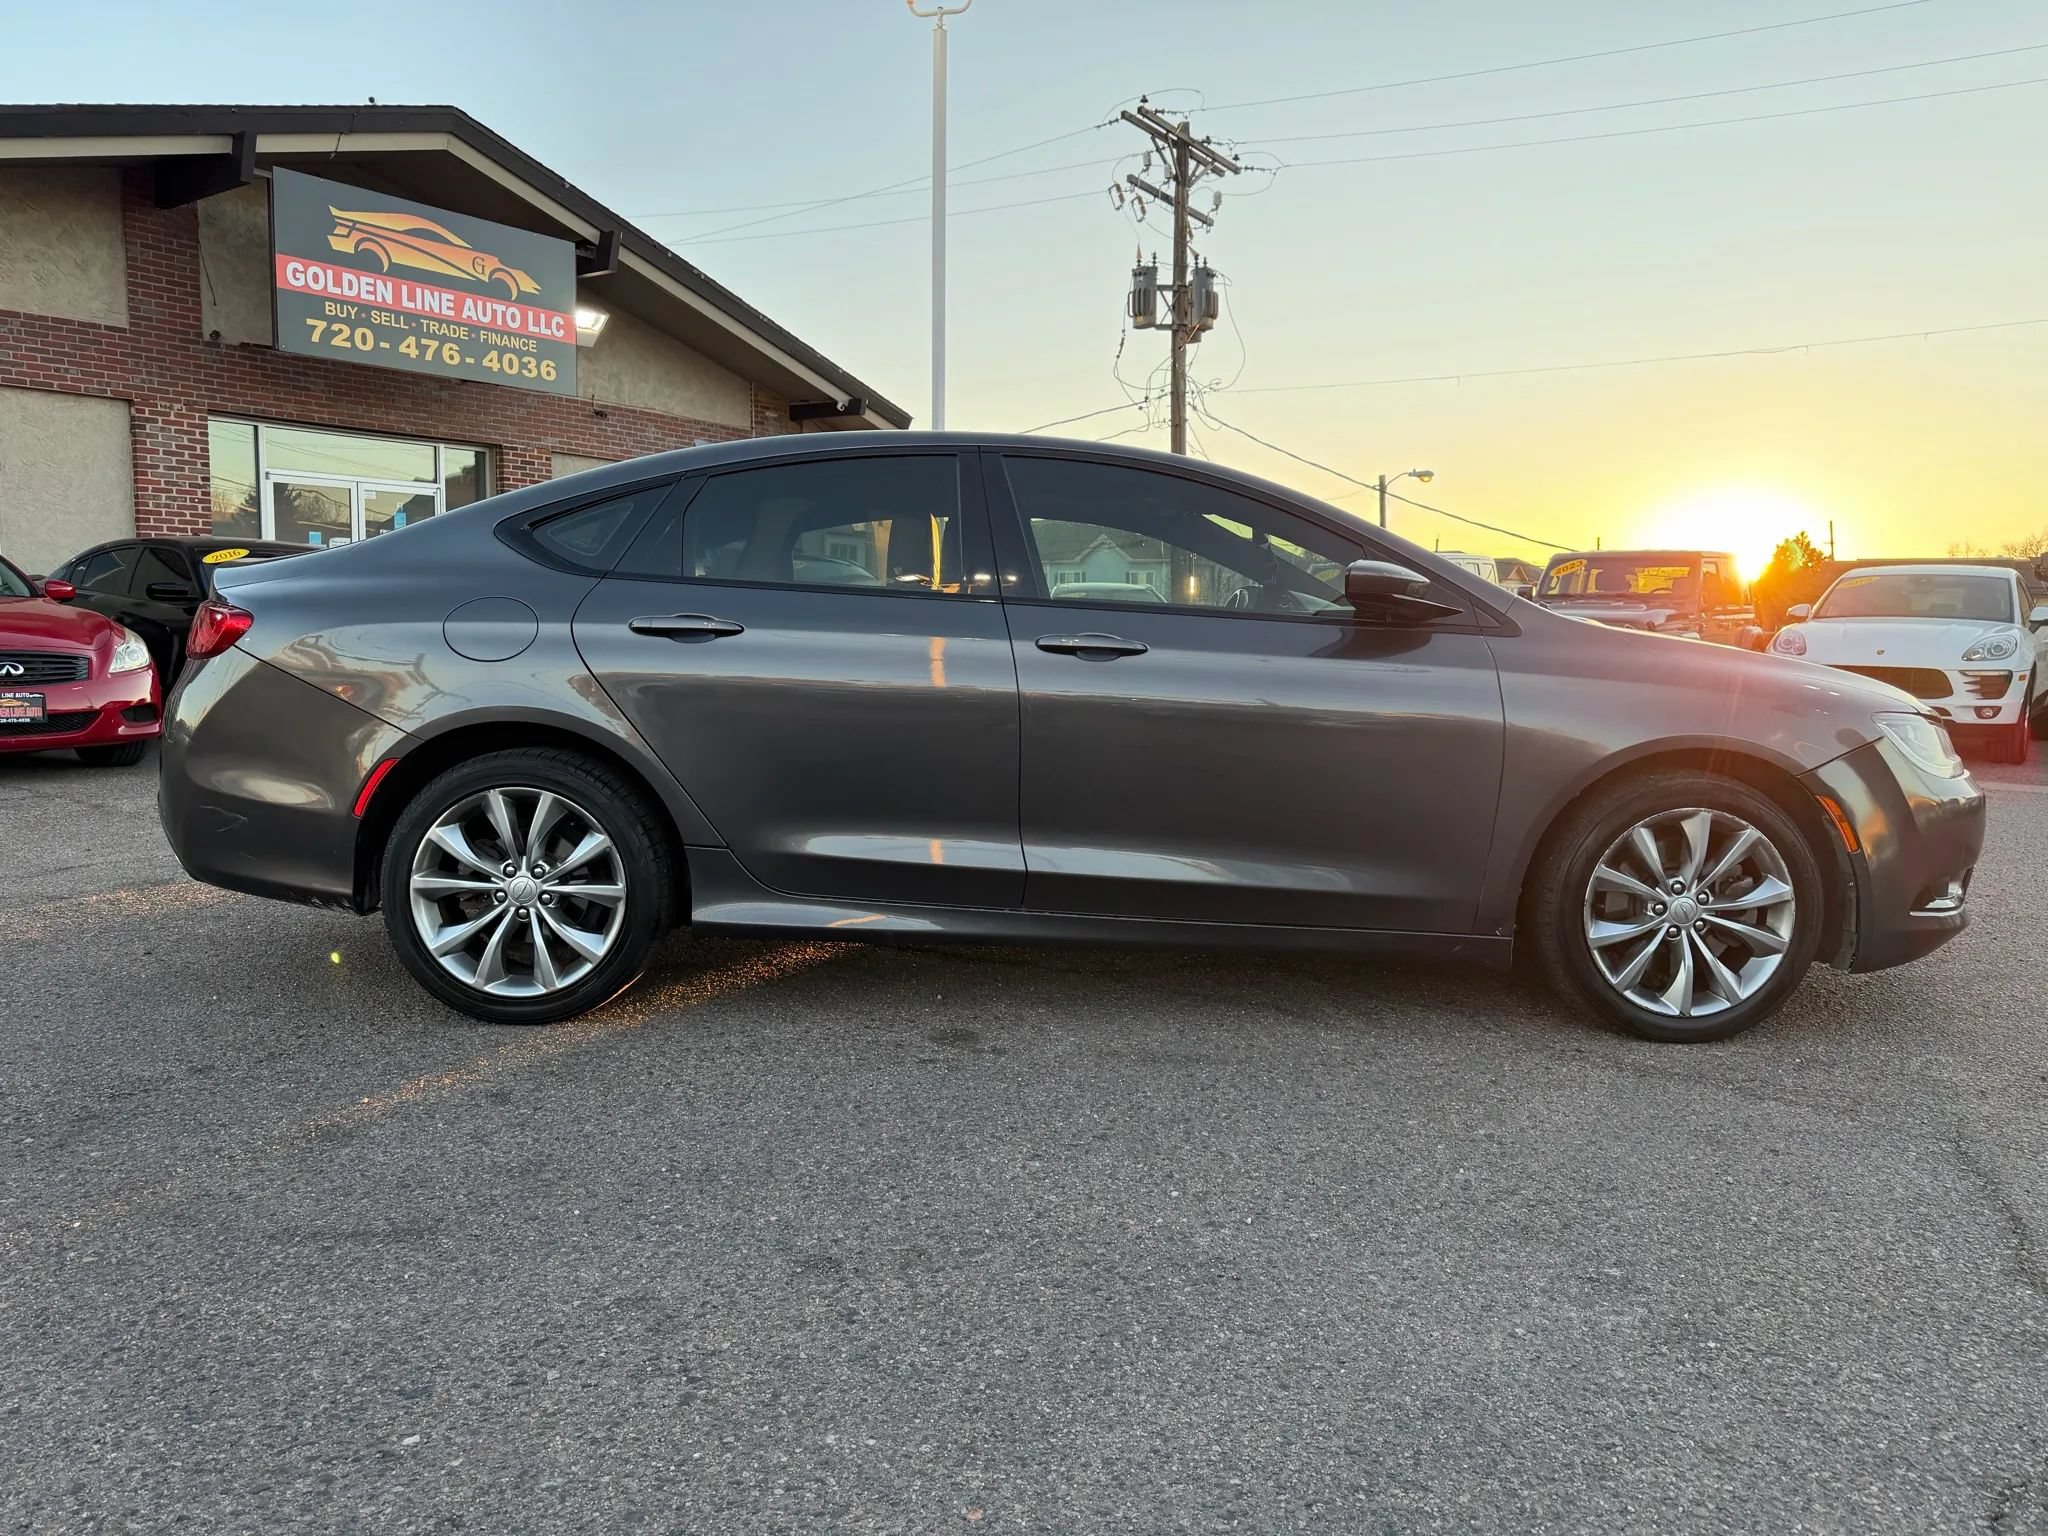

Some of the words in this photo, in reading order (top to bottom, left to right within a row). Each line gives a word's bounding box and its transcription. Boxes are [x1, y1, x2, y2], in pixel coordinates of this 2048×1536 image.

[286, 261, 393, 305] GOLDEN
[401, 284, 455, 317] LINE
[461, 298, 521, 329] AUTO
[527, 310, 565, 338] LLC
[324, 301, 359, 320] BUY
[370, 310, 409, 330] SELL
[421, 319, 469, 340] TRADE
[479, 330, 538, 353] FINANCE
[212, 550, 241, 561] 2016
